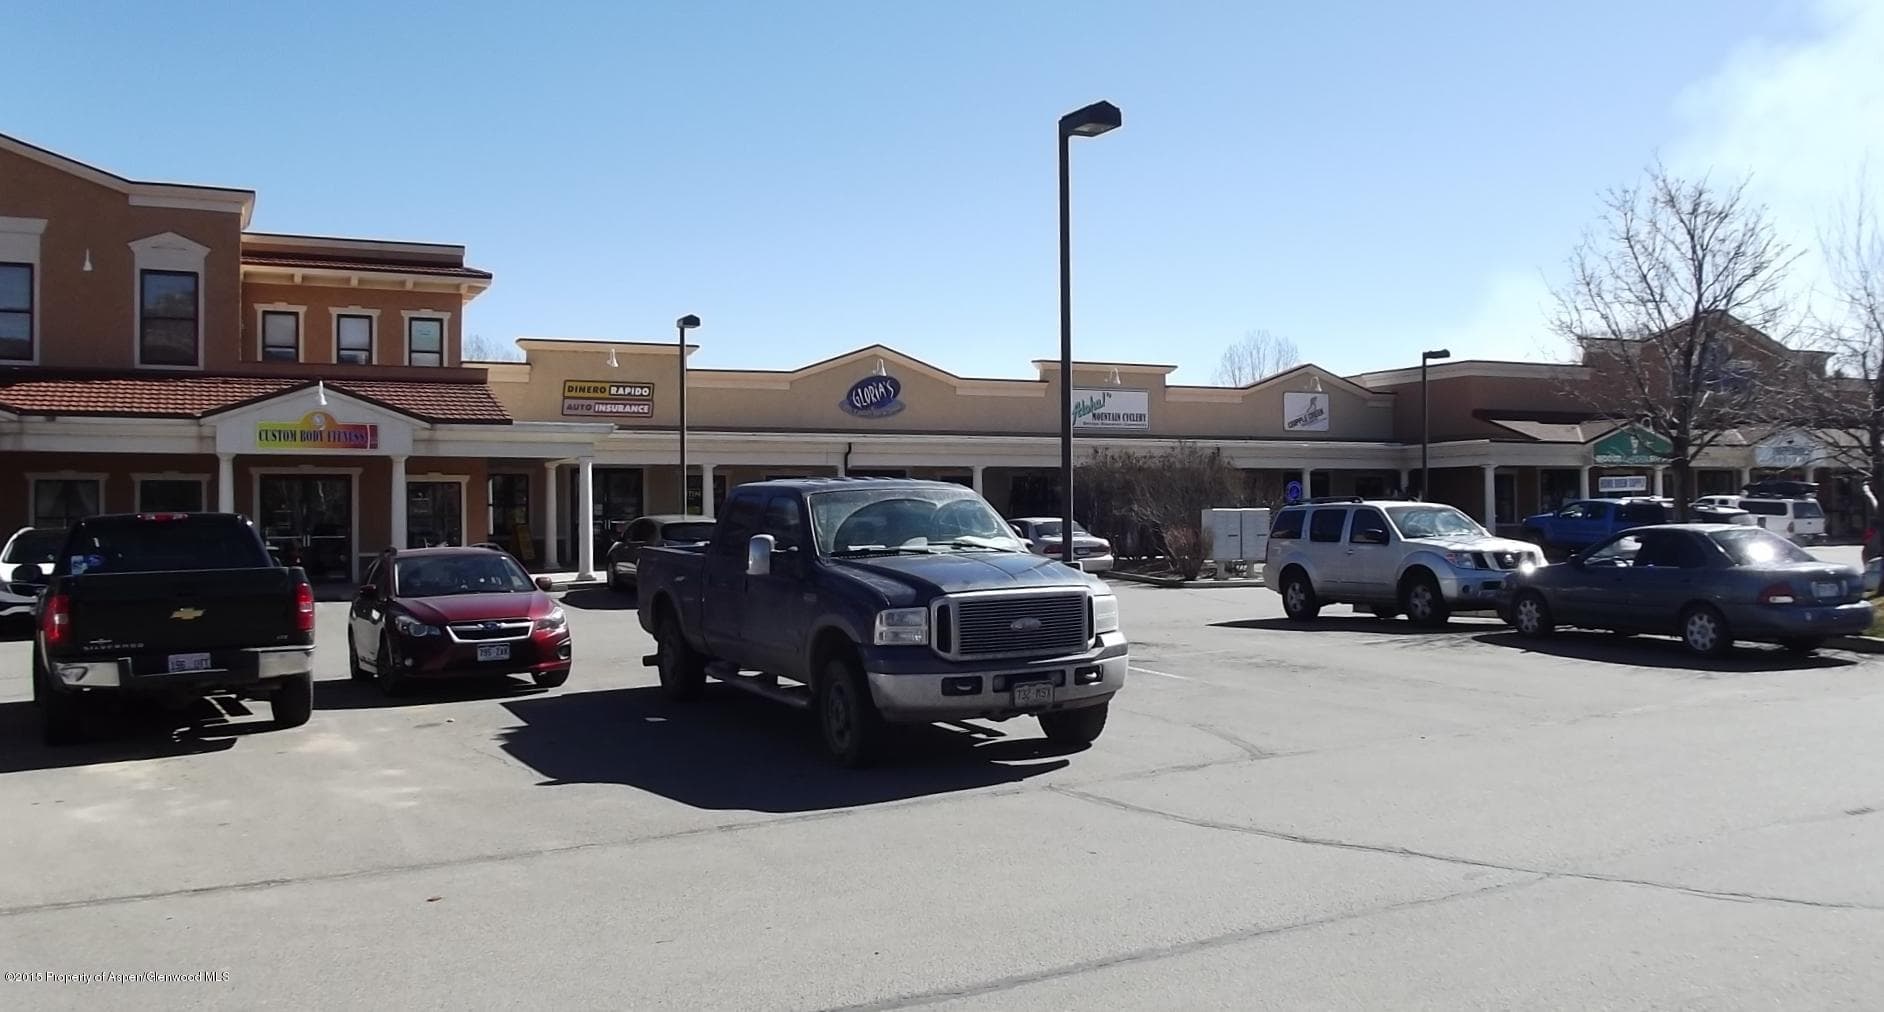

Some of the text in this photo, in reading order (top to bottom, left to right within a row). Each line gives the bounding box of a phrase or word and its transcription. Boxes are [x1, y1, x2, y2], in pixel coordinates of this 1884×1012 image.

[567, 385, 649, 396] DINERO RAPIDO
[852, 380, 895, 408] GLORIA'S
[566, 403, 649, 413] AUTO INSURANCE
[1092, 412, 1147, 422] MOUNTAIN CYCLERY
[259, 429, 297, 442] CUSTOM
[300, 430, 324, 442] BODY
[327, 430, 367, 442] FITNESS
